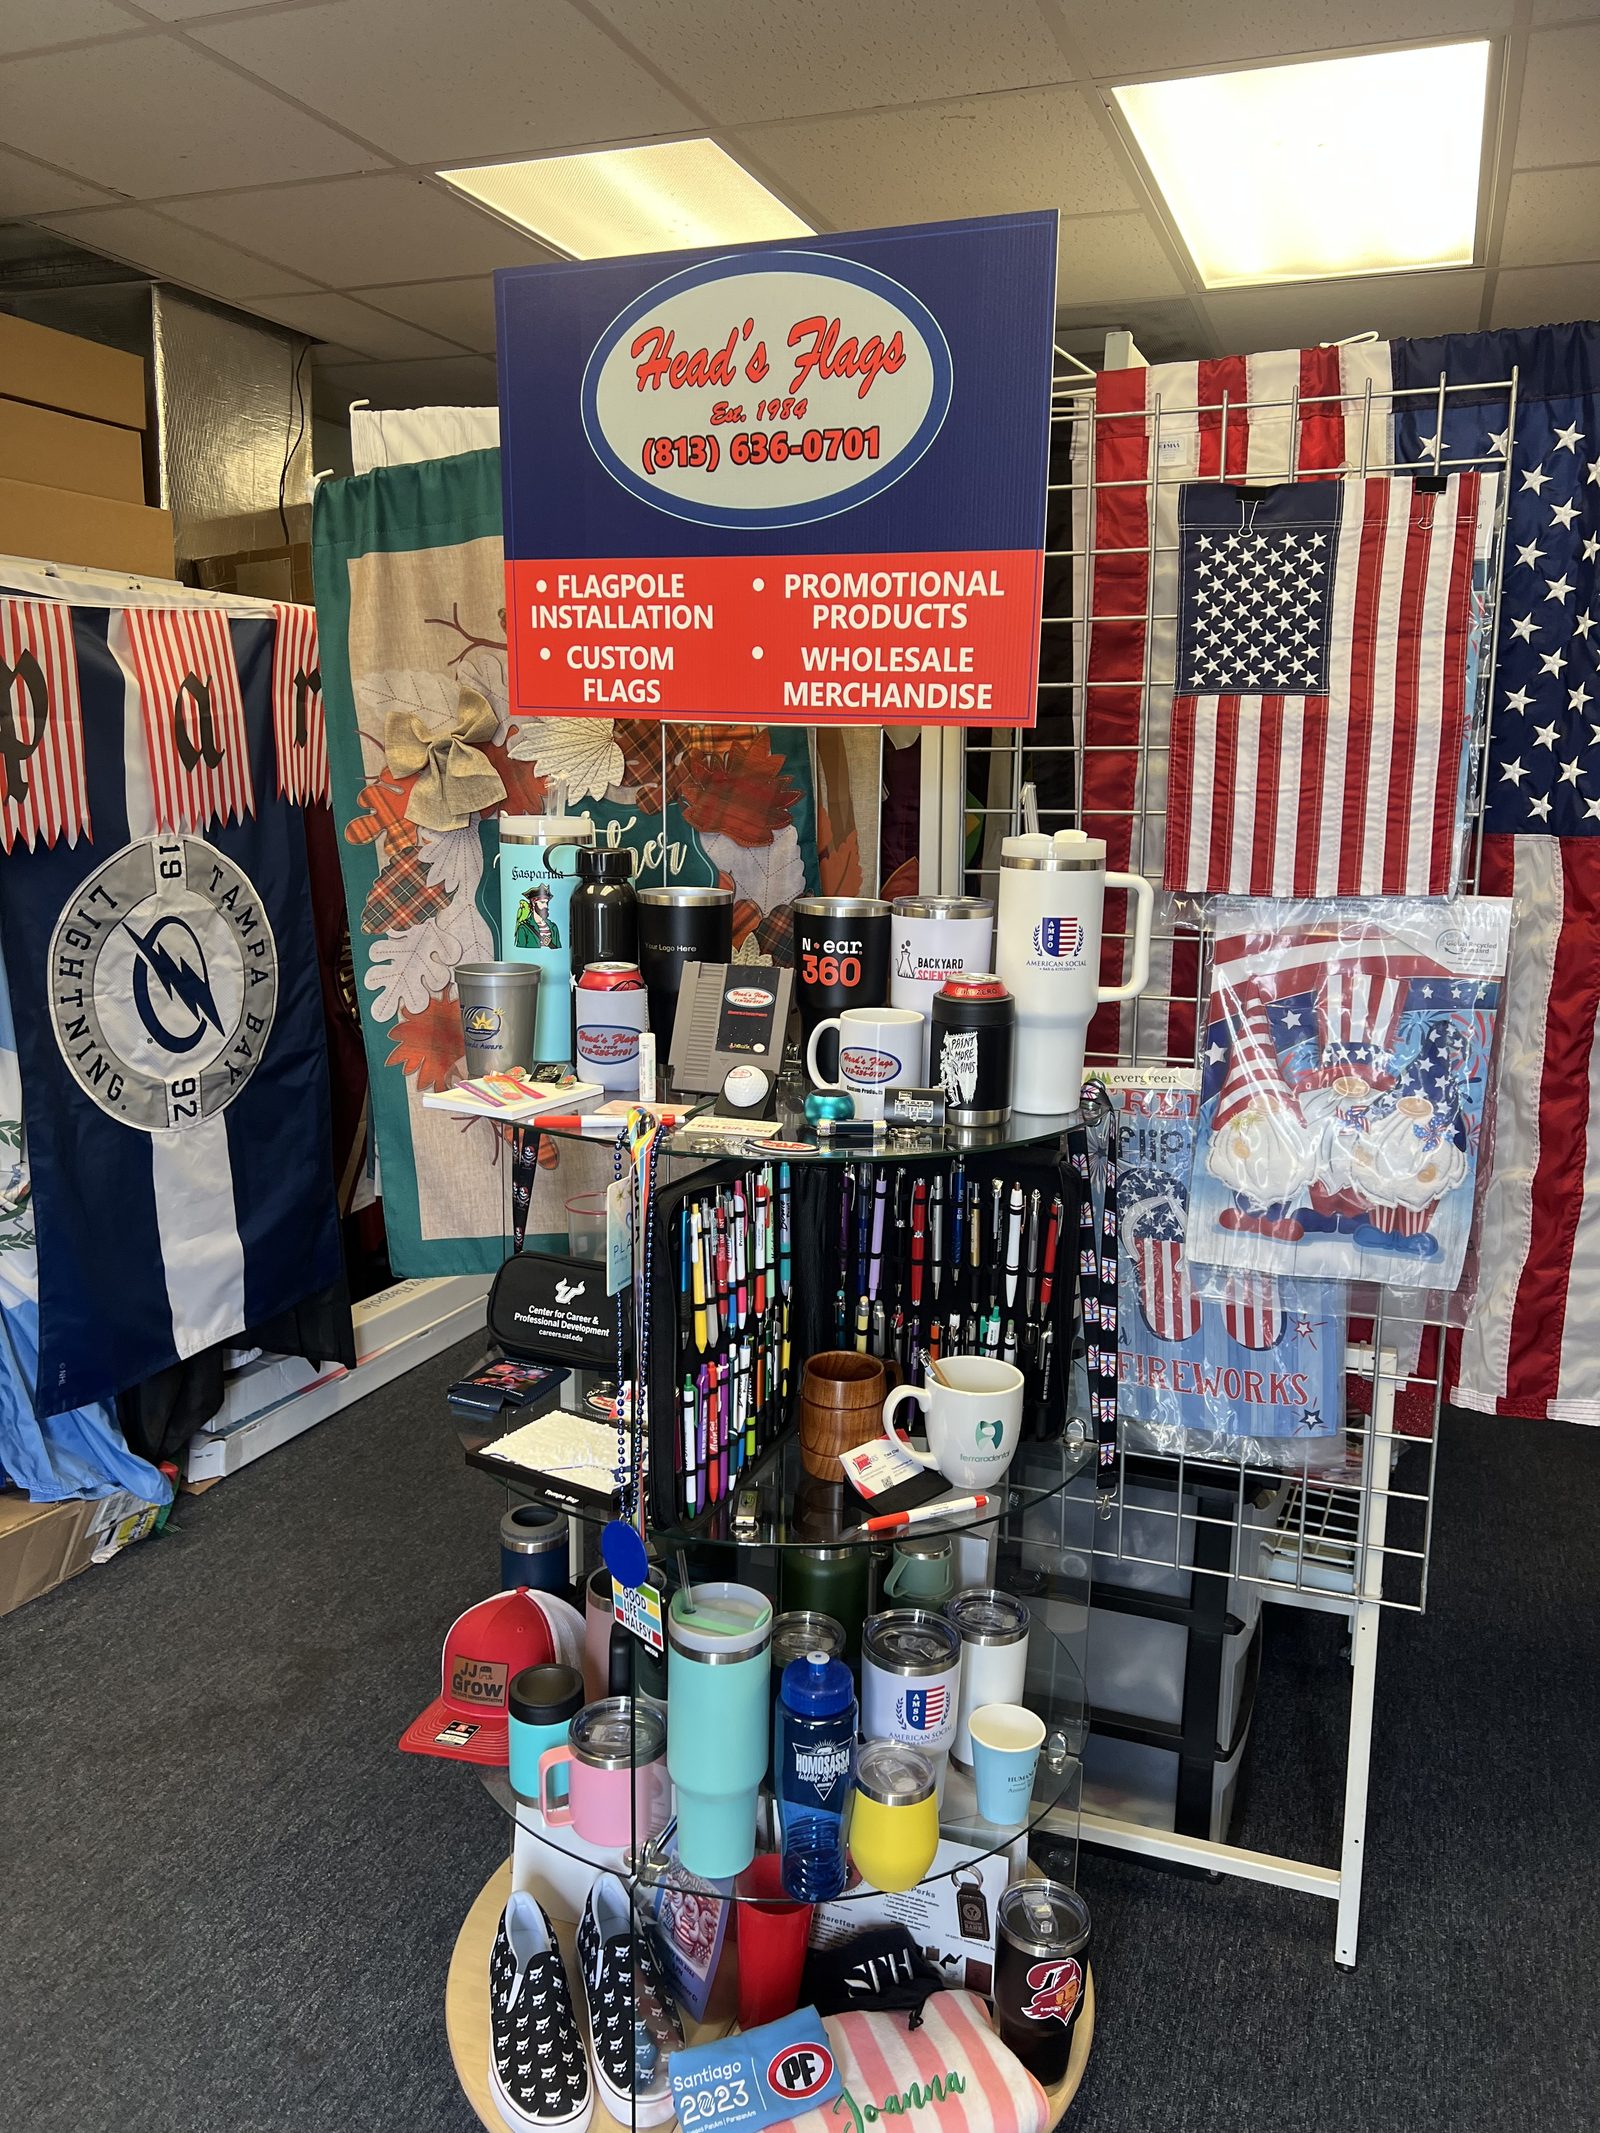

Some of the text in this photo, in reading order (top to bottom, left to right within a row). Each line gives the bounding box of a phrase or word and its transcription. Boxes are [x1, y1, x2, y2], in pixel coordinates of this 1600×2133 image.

[631, 315, 906, 398] Head's Flags
[710, 397, 808, 425] Est. 1984
[642, 426, 880, 474] (813) 636-0701
[557, 574, 684, 599] FLAGPOLE
[785, 570, 1004, 598] PROMOTIONAL
[531, 605, 713, 630] INSTALLATION
[812, 603, 968, 630] PRODUCTS
[567, 645, 674, 671] CUSTOM
[801, 647, 974, 673] WHOLESALE
[582, 678, 661, 704] FLAGS
[783, 682, 992, 710] MERCHANDISE
[159, 844, 182, 879] 19
[659, 944, 676, 952] Logo
[676, 944, 698, 952] Here
[212, 864, 269, 1086] TAMPA BAY
[802, 954, 861, 987] 360
[918, 957, 964, 970] BACKYARD
[951, 1036, 976, 1050] PAINT
[955, 1048, 974, 1061] MORE
[843, 1052, 866, 1065] Head's
[869, 1057, 894, 1069] Flags
[171, 1077, 198, 1122] 92
[514, 1312, 610, 1337] Professional Development
[528, 1305, 599, 1325] Center for Career &
[1117, 1350, 1309, 1406] FIREWORKS
[623, 1587, 647, 1610] GOOD
[623, 1601, 638, 1617] LIFE
[624, 1614, 652, 1640] HALFSY
[461, 1663, 477, 1678] JJ
[453, 1673, 503, 1698] Grow
[889, 1731, 930, 1741] AMERICAN
[796, 1748, 849, 1775] HOMOSASSA
[673, 2061, 741, 2092] Santiago
[781, 2052, 816, 2090] PF
[680, 2079, 749, 2126] 2023
[832, 2070, 966, 2133] Joanna
